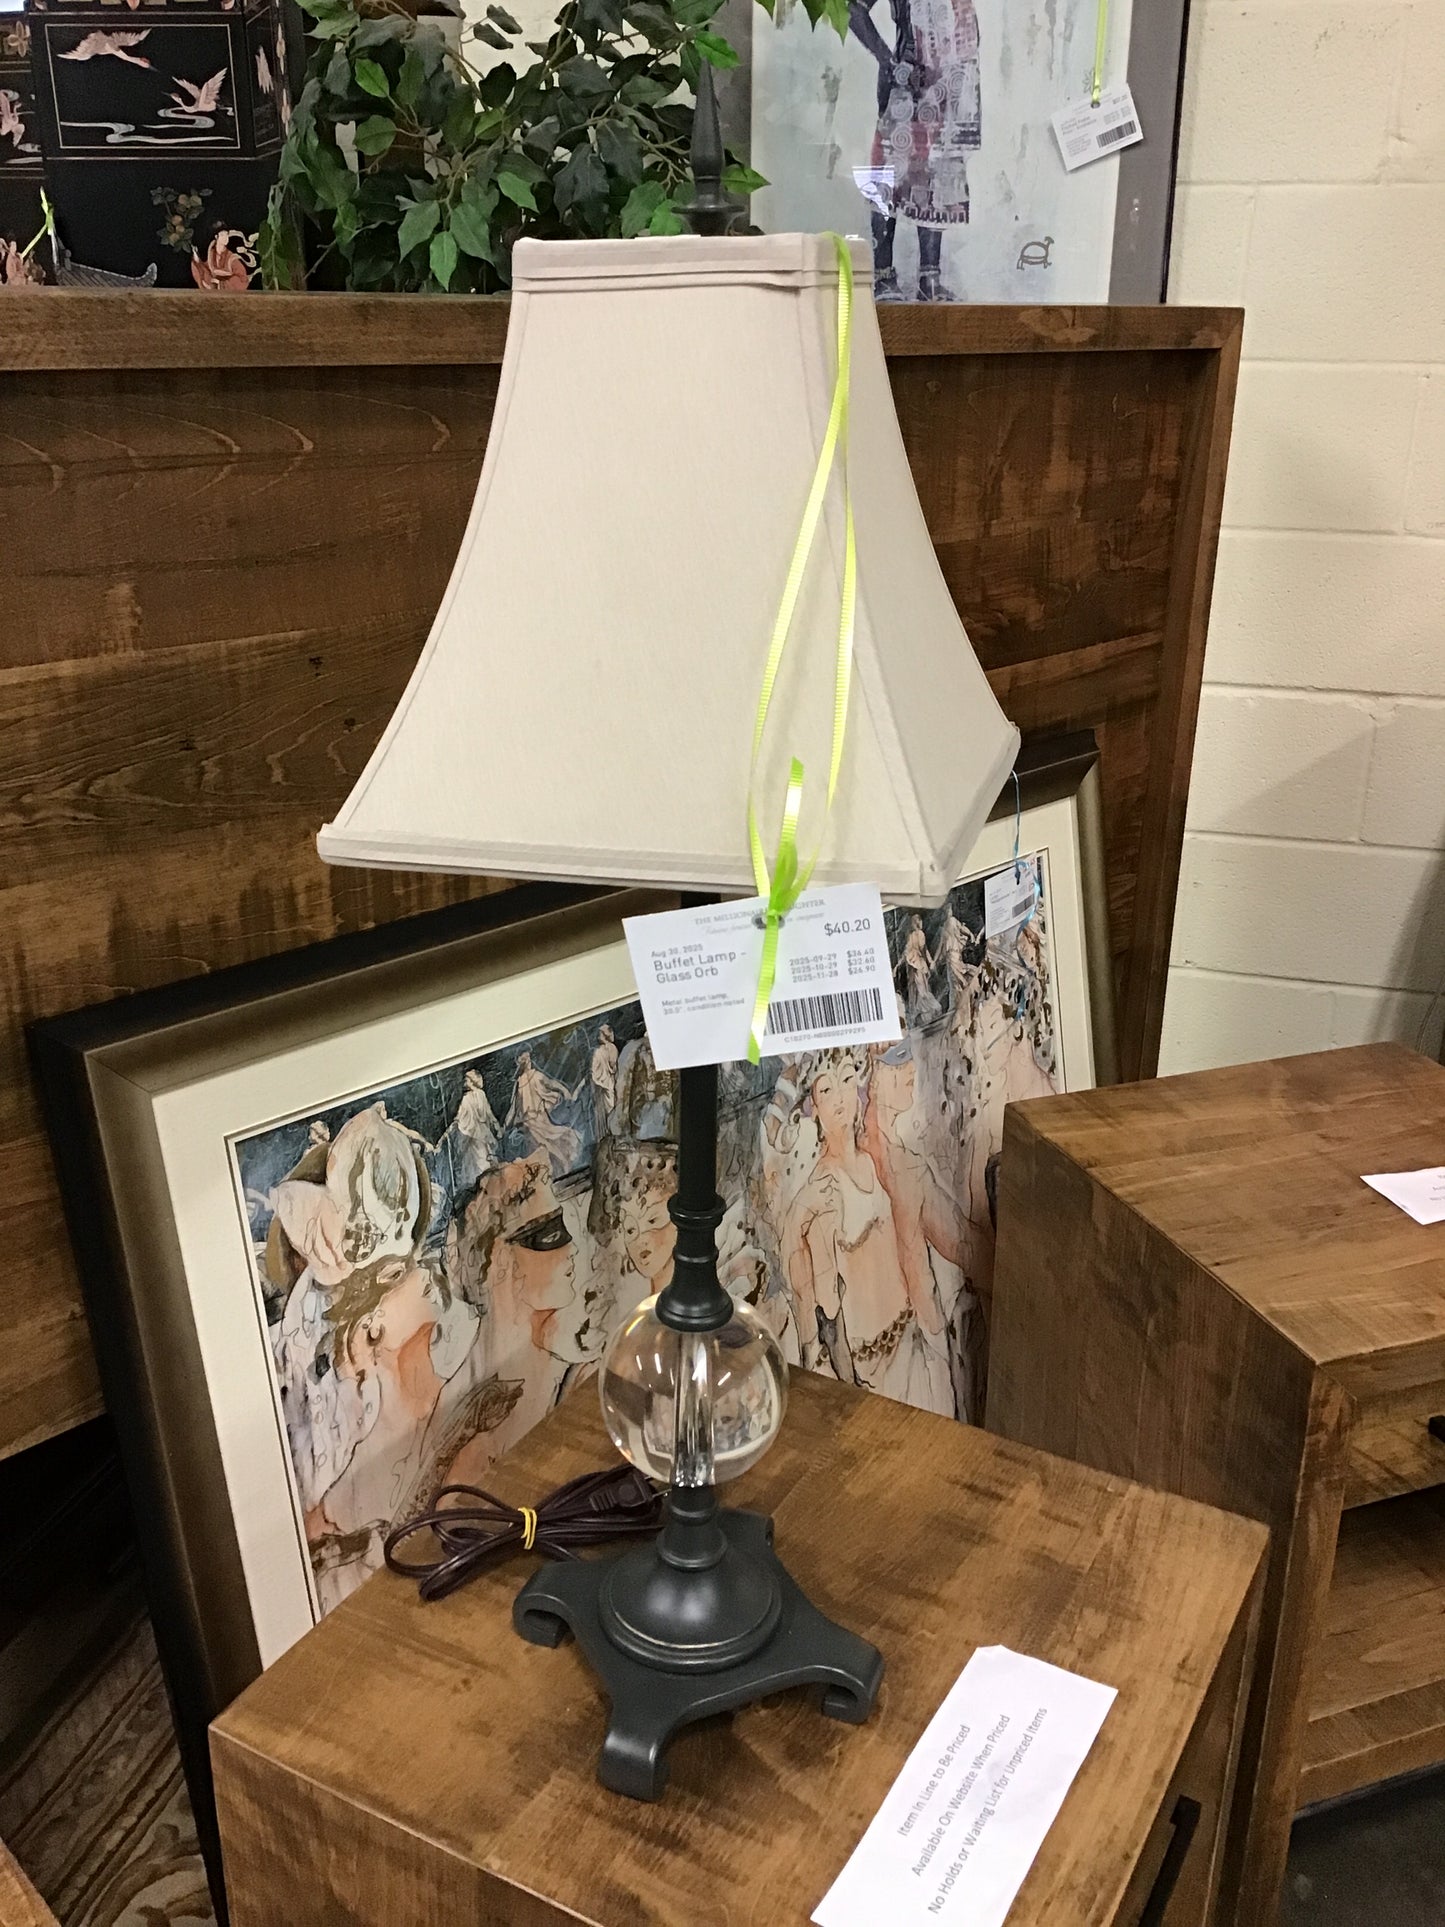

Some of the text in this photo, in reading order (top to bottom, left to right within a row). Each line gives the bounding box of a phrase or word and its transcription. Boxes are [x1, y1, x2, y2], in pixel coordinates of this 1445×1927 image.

[824, 918, 871, 936] $40.20
[651, 950, 667, 958] Aug
[653, 956, 695, 971] Buffet
[698, 951, 736, 964] Lamp
[656, 965, 719, 984] Glass Orb
[790, 961, 838, 974] 2025-10-29
[792, 970, 839, 983] 2025-11-28
[661, 998, 682, 1006] Metal
[684, 994, 707, 1004] buffet
[897, 1724, 971, 1836] Item In Line to Be Priced
[911, 1714, 1010, 1877] Available On Website When Priced
[928, 1707, 1048, 1914] No Holds or Waiting List for Unpriced Items
